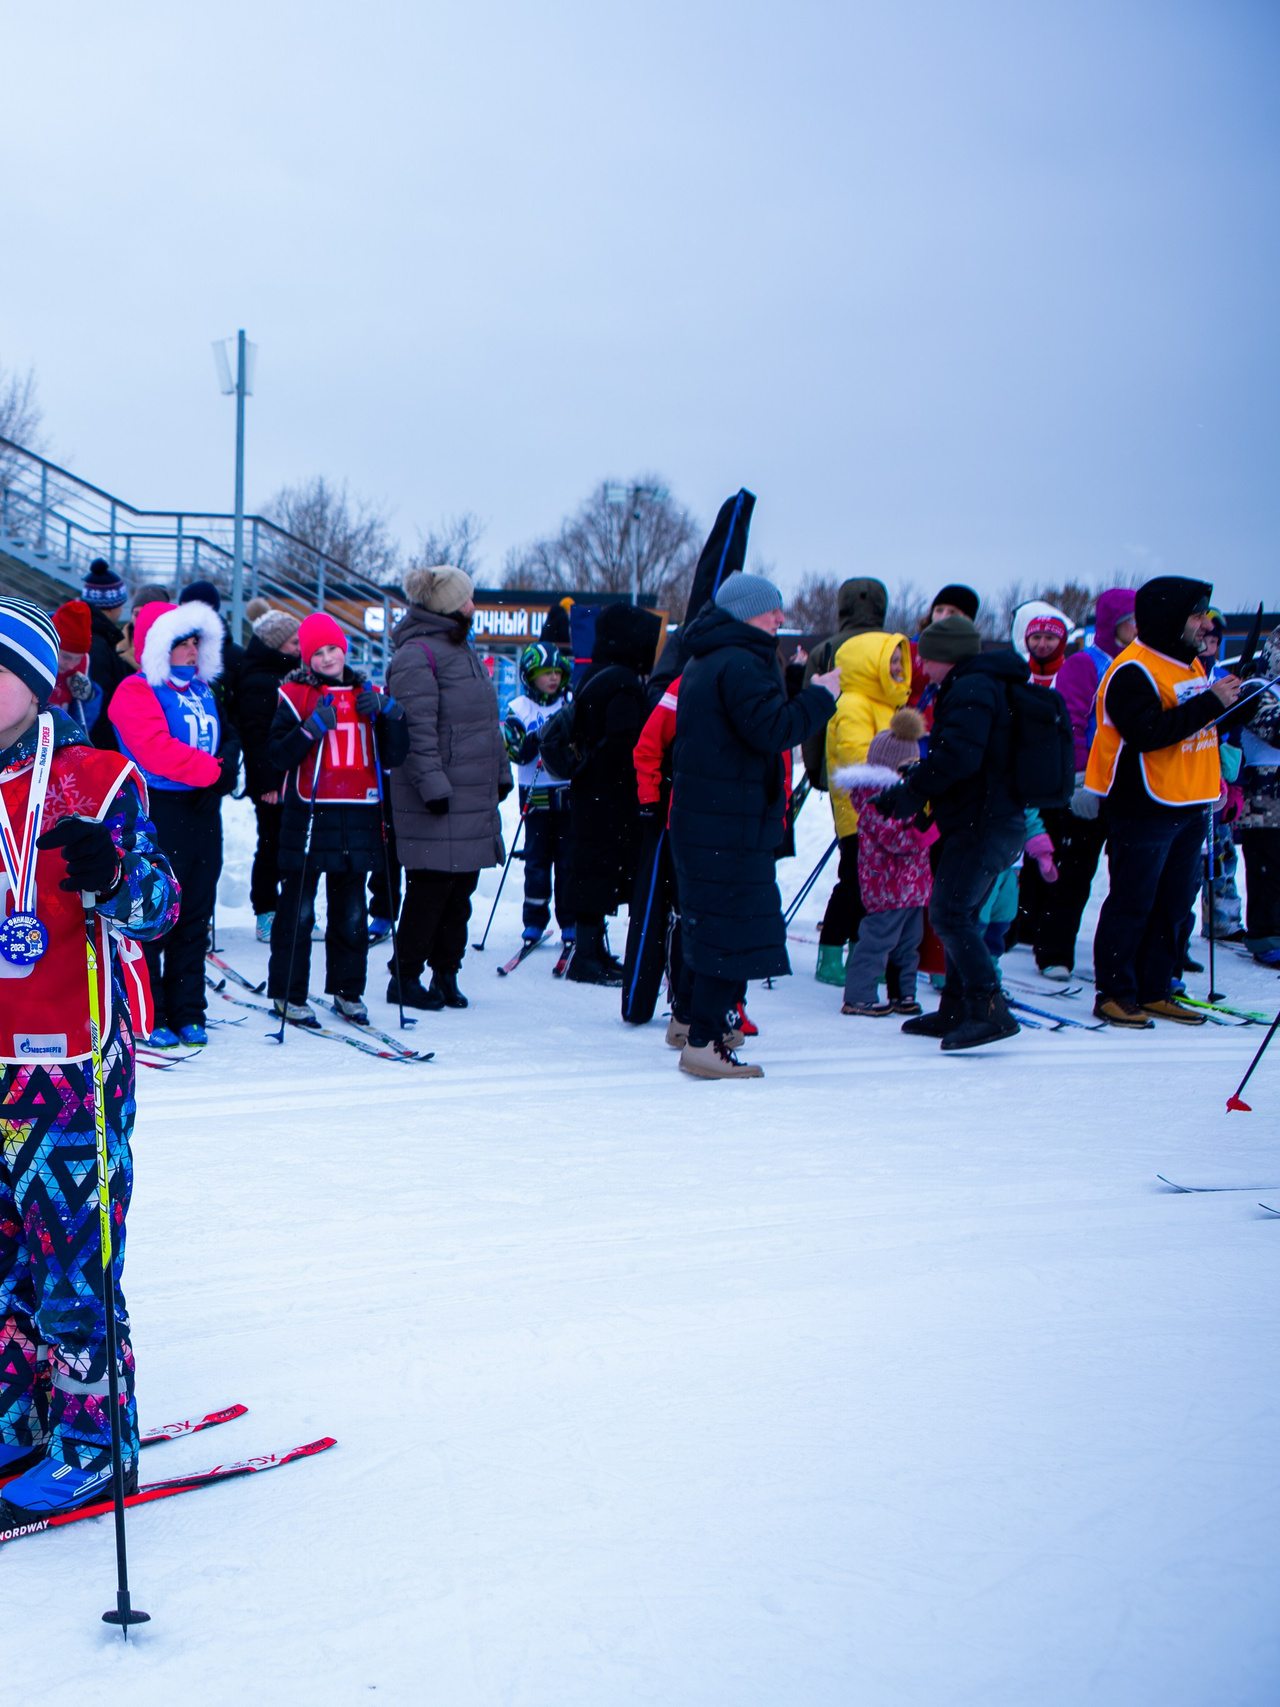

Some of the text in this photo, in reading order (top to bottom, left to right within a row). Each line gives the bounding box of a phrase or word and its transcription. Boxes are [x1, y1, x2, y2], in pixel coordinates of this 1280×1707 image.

[473, 608, 528, 636] ОЧНЫЙ
[41, 726, 50, 747] ГЕРОЕВ
[90, 1017, 101, 1055] SPRINT
